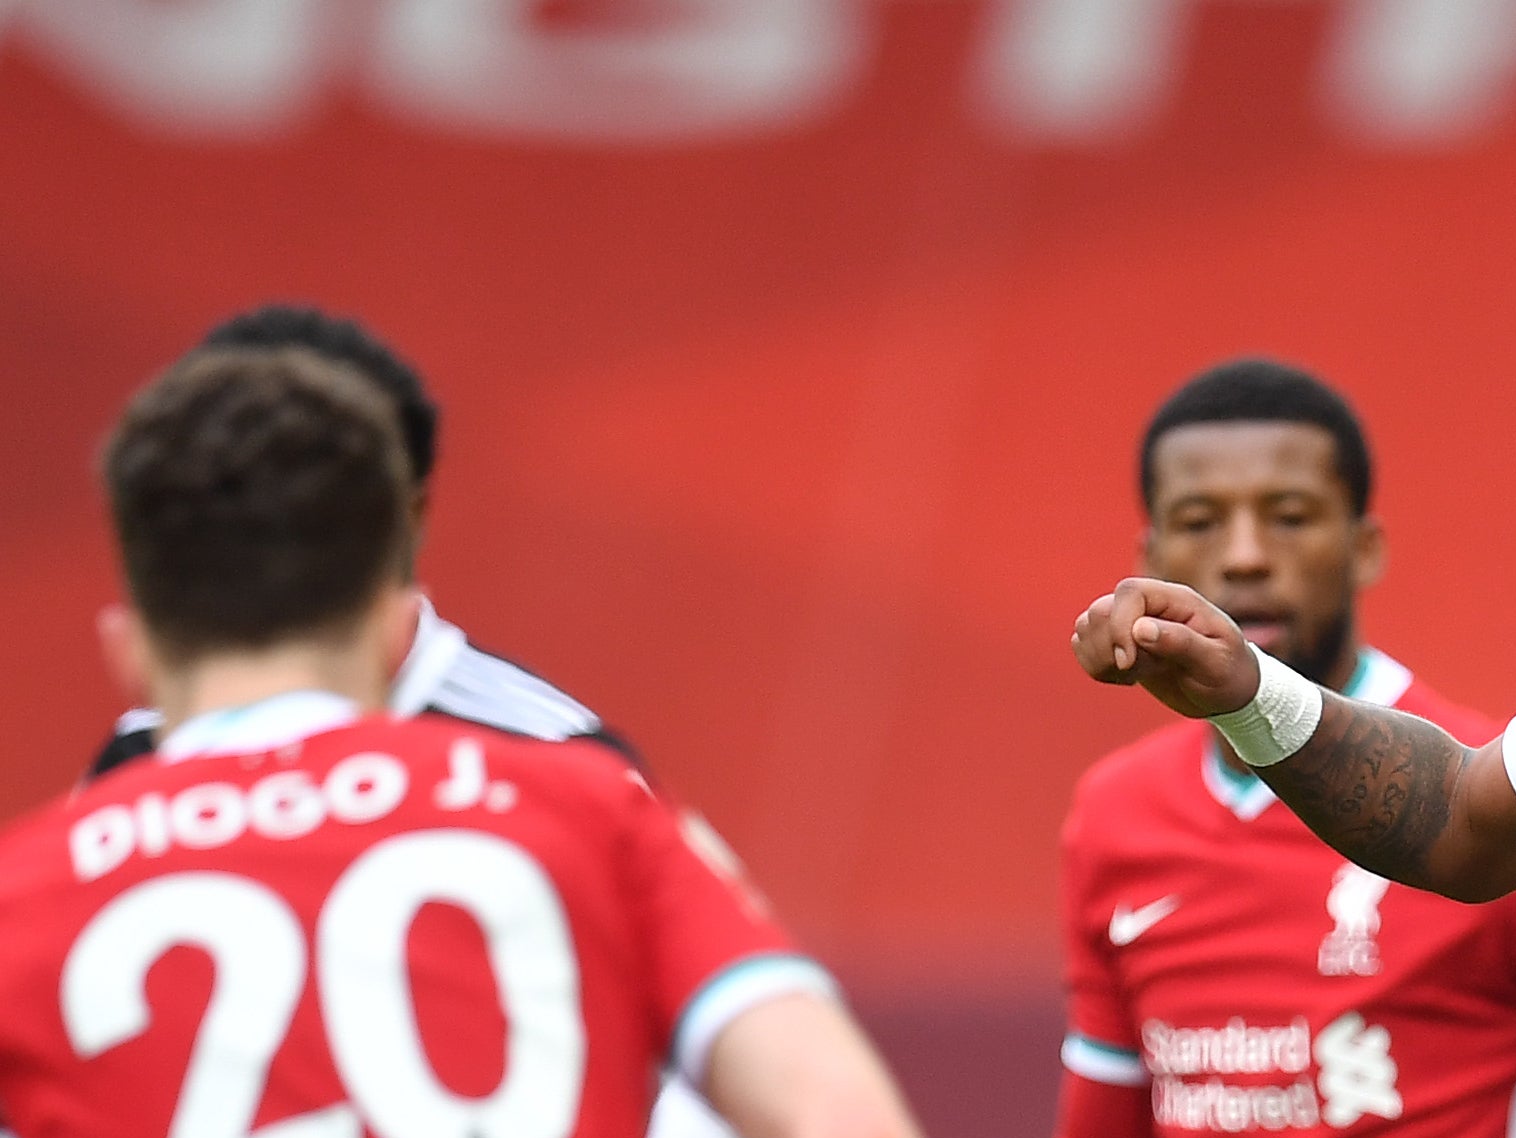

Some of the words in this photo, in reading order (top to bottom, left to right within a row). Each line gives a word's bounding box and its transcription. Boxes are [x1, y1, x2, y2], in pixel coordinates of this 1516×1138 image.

[68, 751, 409, 883] DIOGO
[433, 738, 518, 813] J.
[1142, 1014, 1311, 1076] Standard
